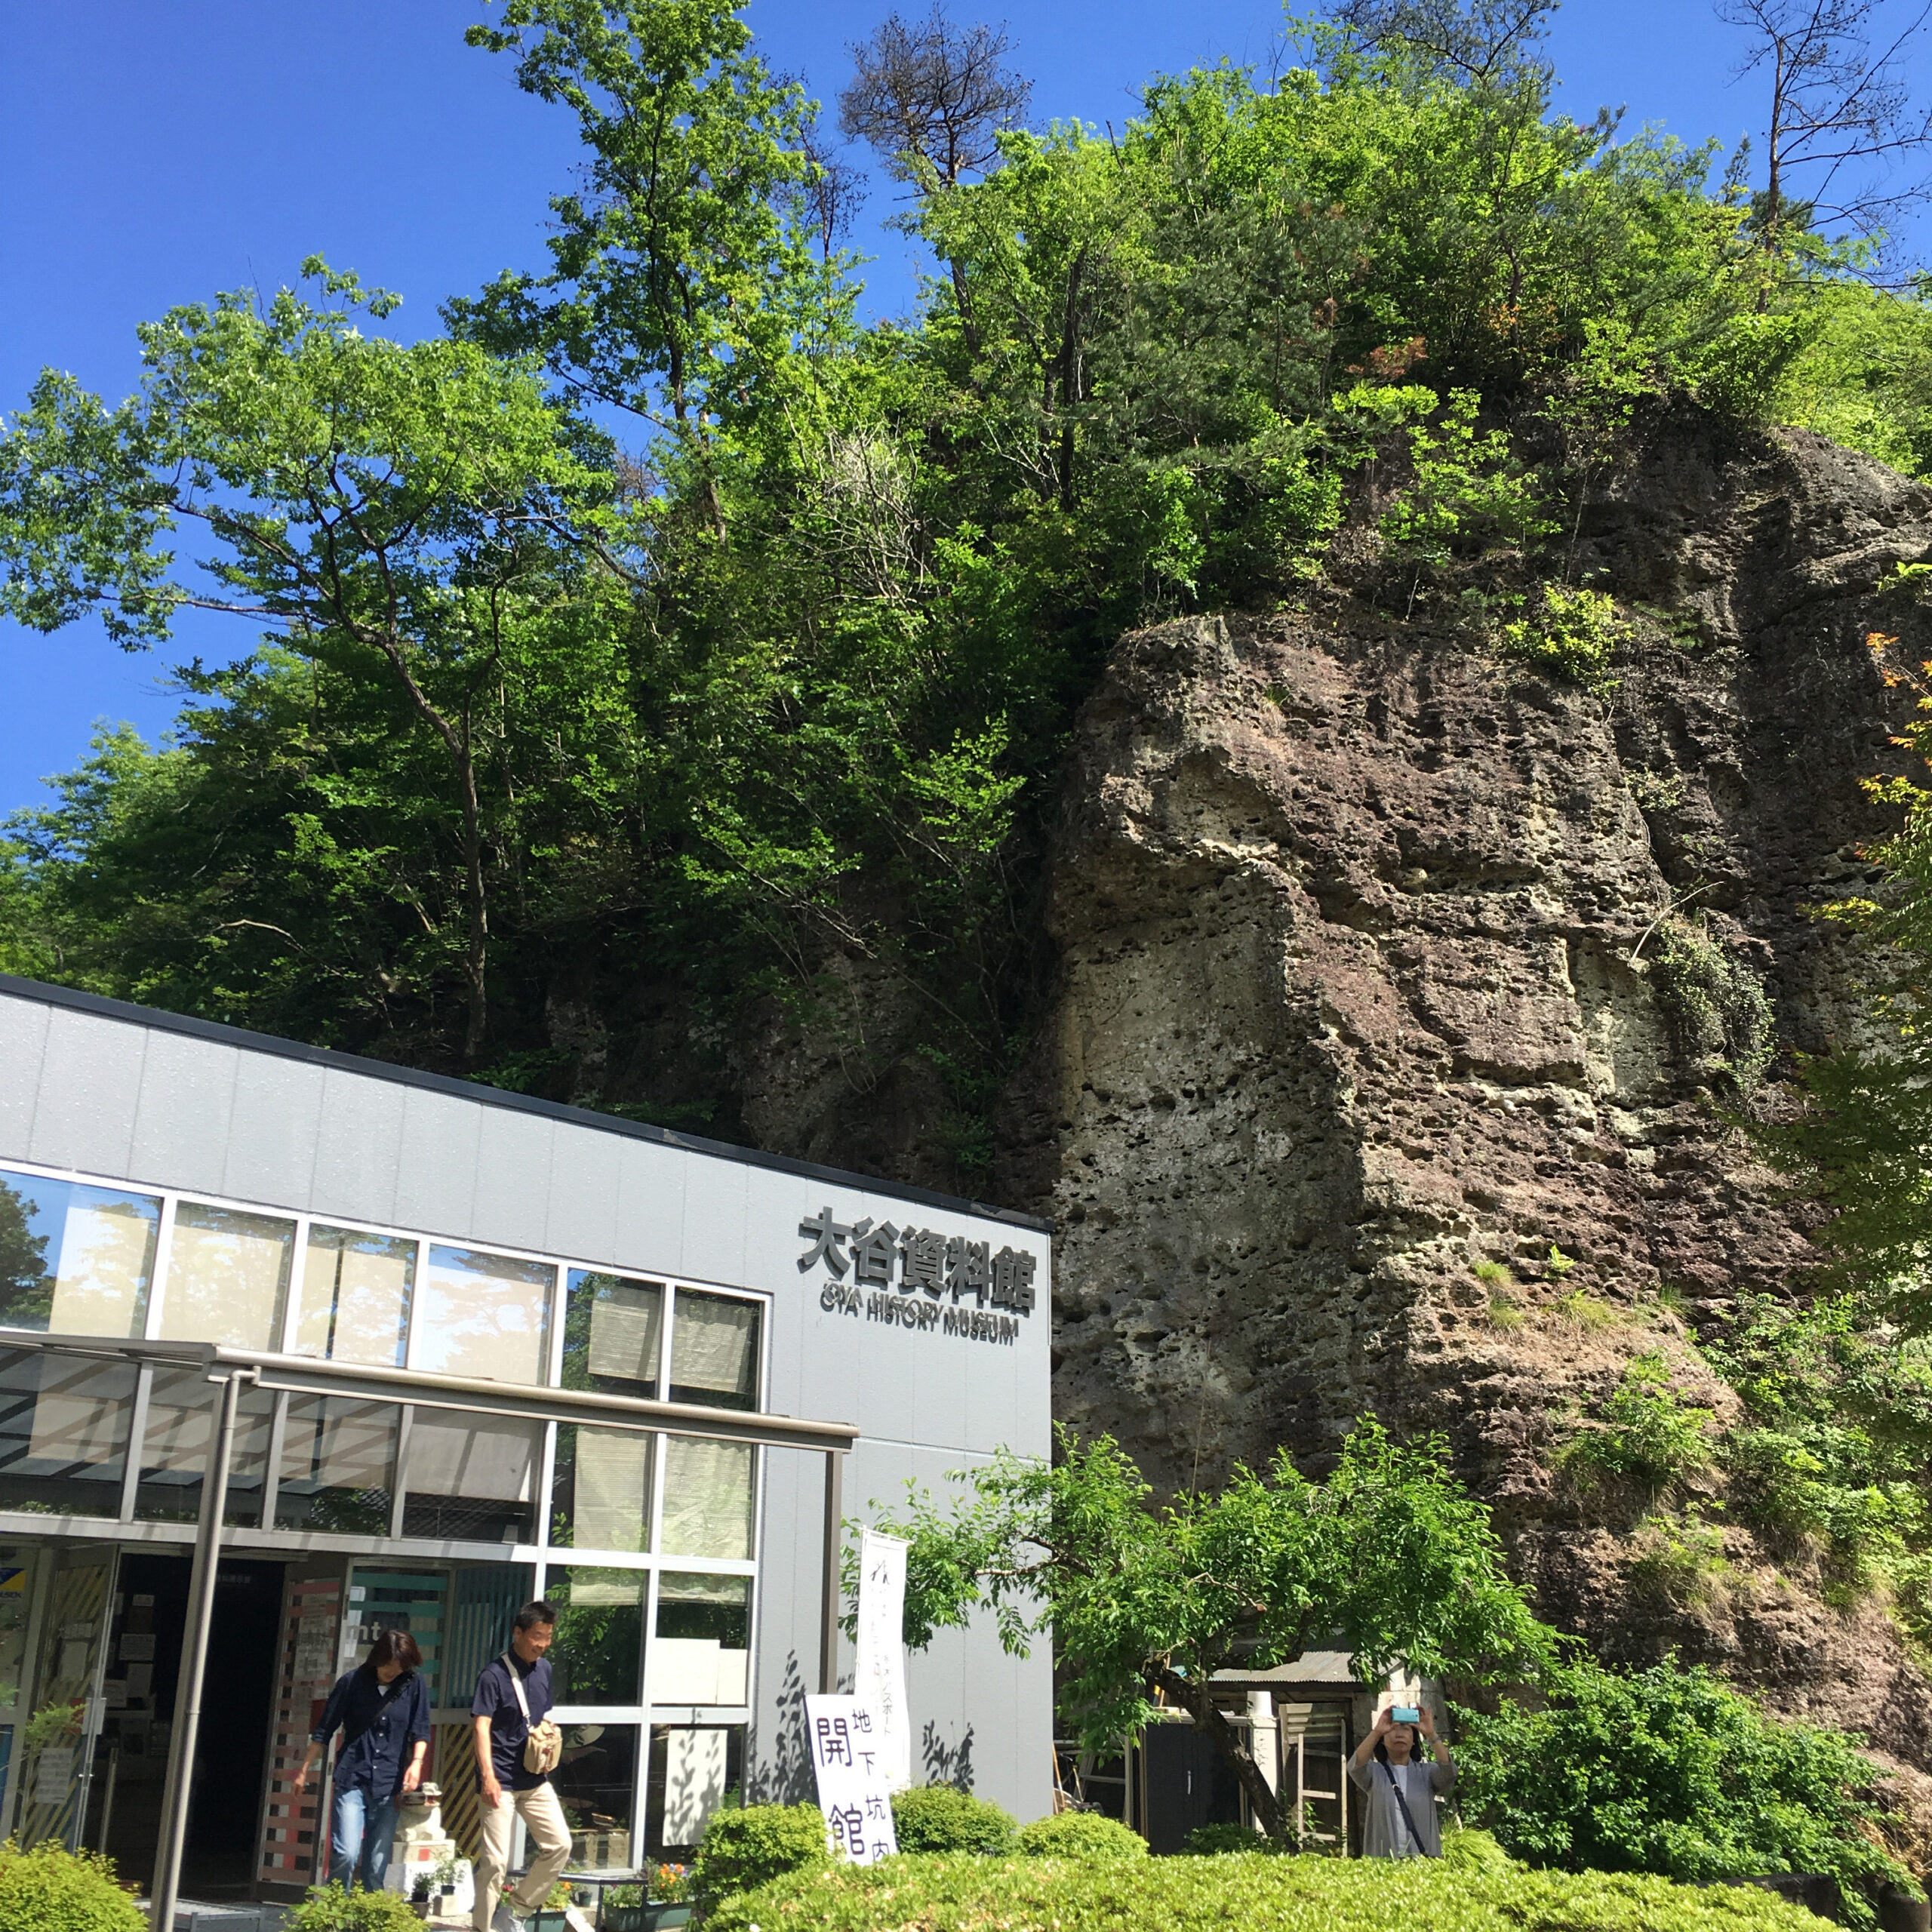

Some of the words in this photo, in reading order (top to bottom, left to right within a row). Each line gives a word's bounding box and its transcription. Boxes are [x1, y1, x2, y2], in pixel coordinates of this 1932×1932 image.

[800, 1205, 1037, 1312] 大谷資料館
[869, 1291, 945, 1329] HISTORY
[946, 1306, 1020, 1343] MUSEUM
[817, 1717, 866, 1856] 開館
[852, 1709, 890, 1862] 地下坑内
